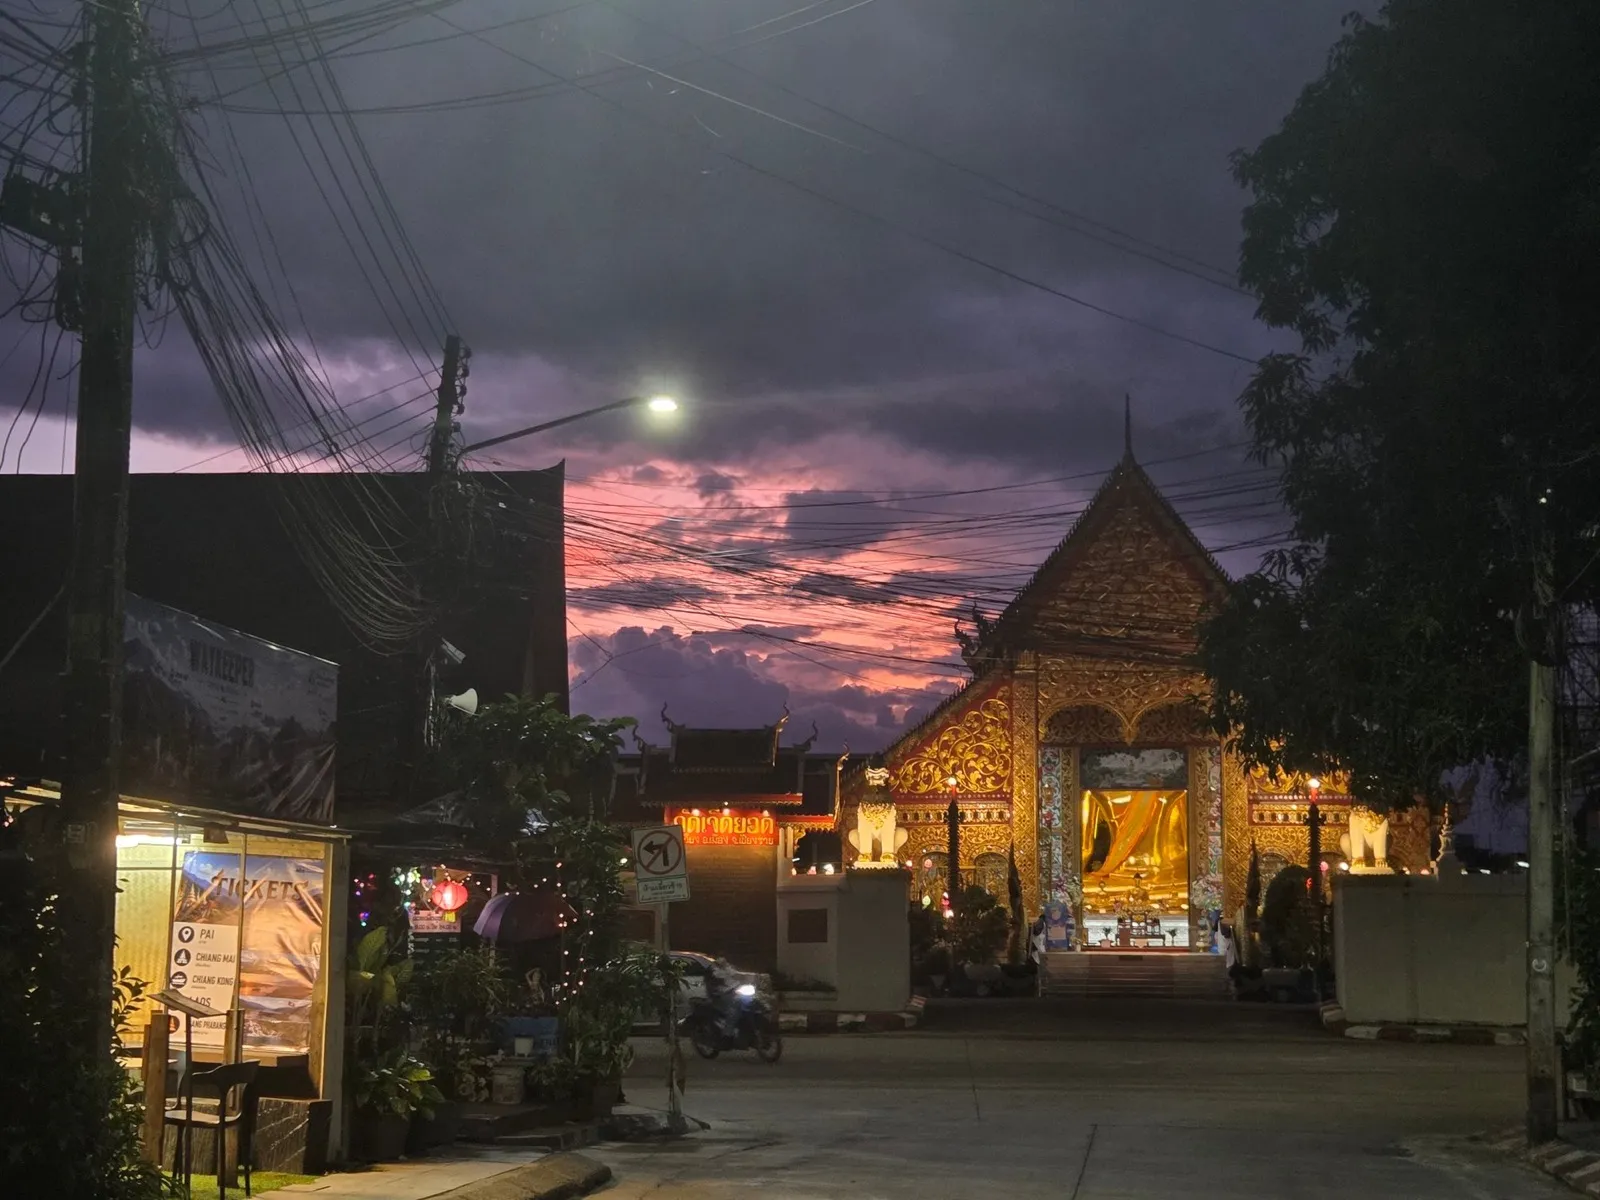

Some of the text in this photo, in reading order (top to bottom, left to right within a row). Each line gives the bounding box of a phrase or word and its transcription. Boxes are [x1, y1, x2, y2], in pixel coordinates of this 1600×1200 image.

[673, 808, 774, 835] วัดเจ็ดยอด
[211, 875, 310, 901] TICKETS
[199, 928, 215, 940] PAI
[195, 952, 236, 964] CHIANG MAI
[192, 975, 234, 987] CHIANG KONG
[190, 996, 212, 1007] AOS
